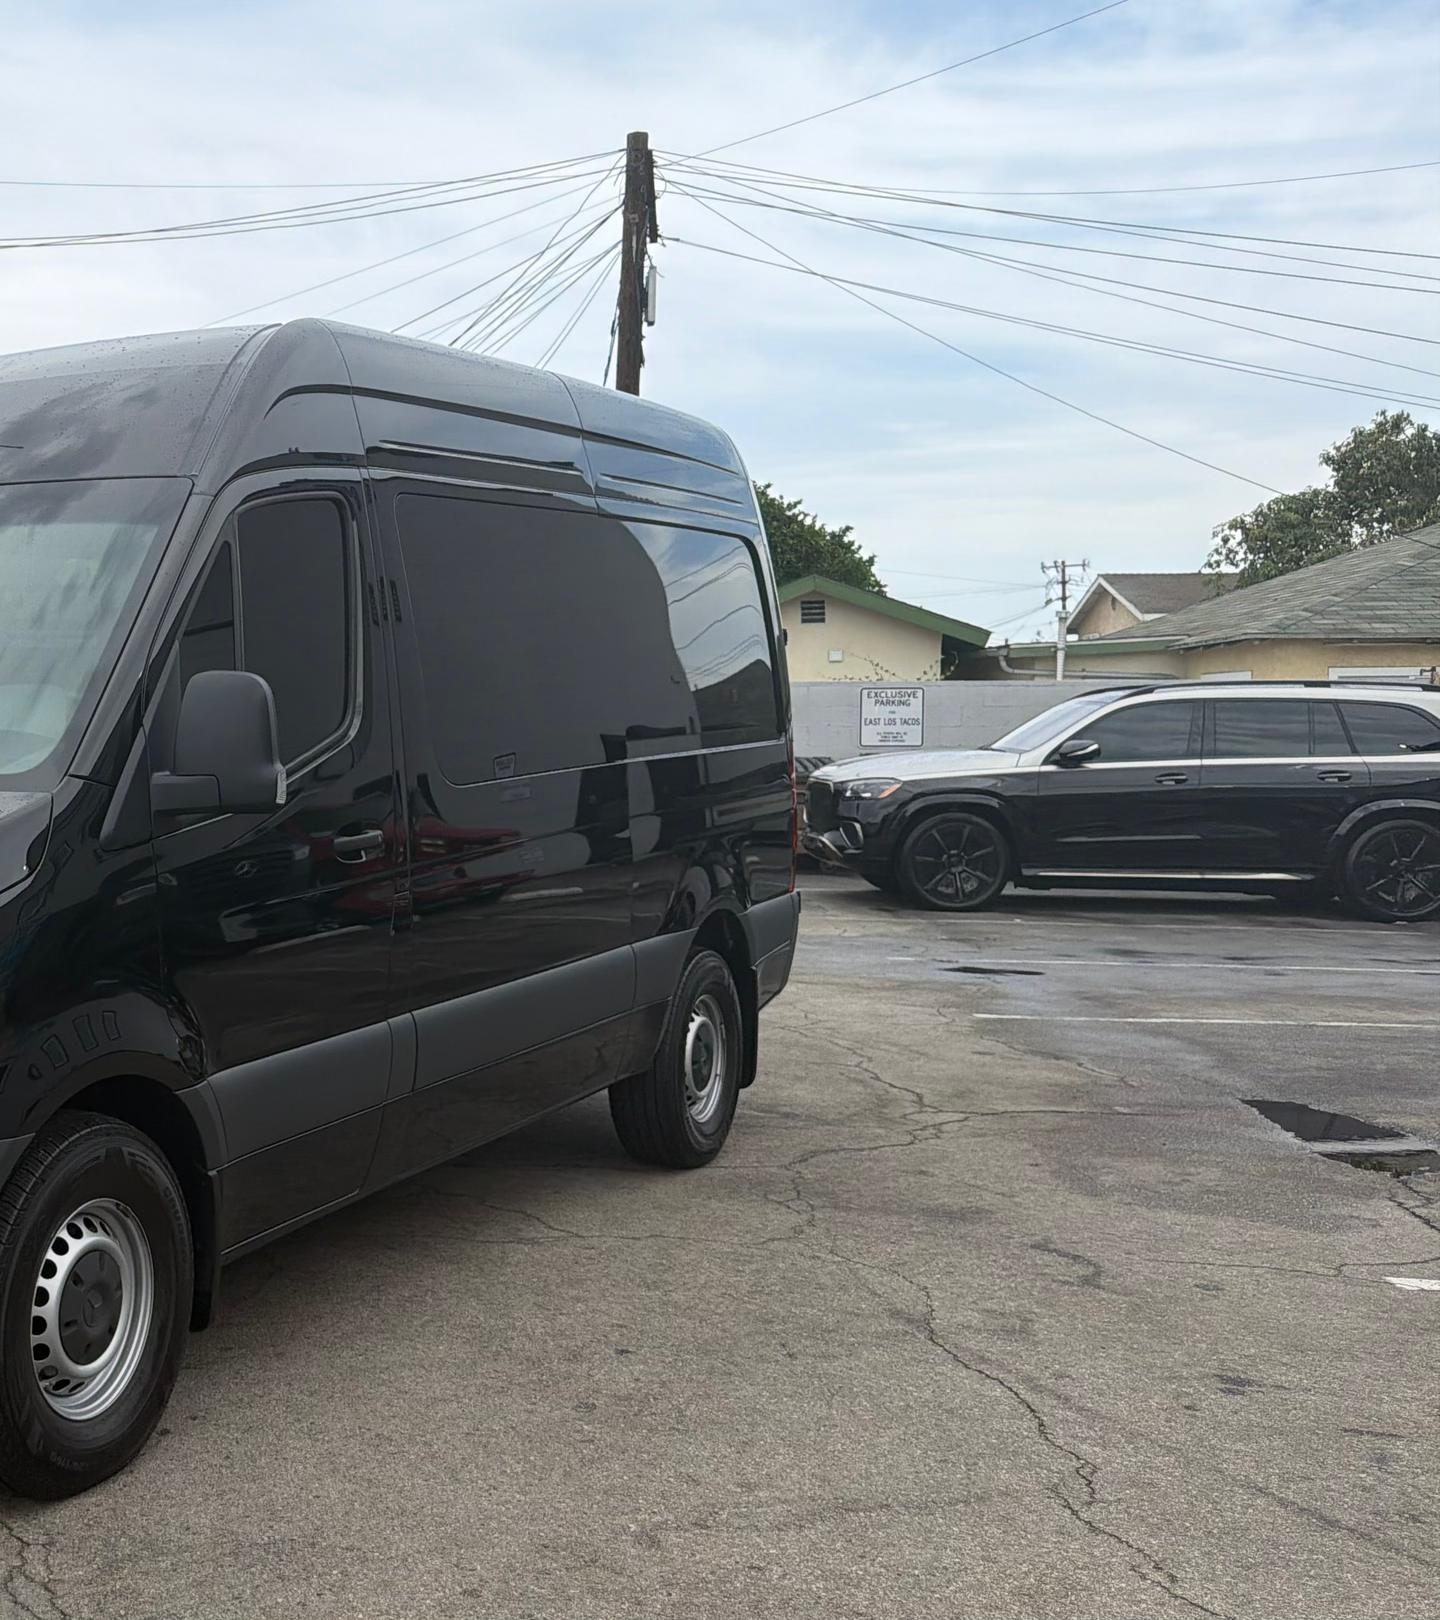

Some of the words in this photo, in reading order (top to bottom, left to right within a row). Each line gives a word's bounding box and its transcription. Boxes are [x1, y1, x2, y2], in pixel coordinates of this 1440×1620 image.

[867, 690, 919, 699] EXCLUSIVE
[874, 699, 911, 707] PARKING
[864, 718, 881, 726] EAST
[883, 718, 897, 726] LOS
[900, 718, 921, 726] TACOS
